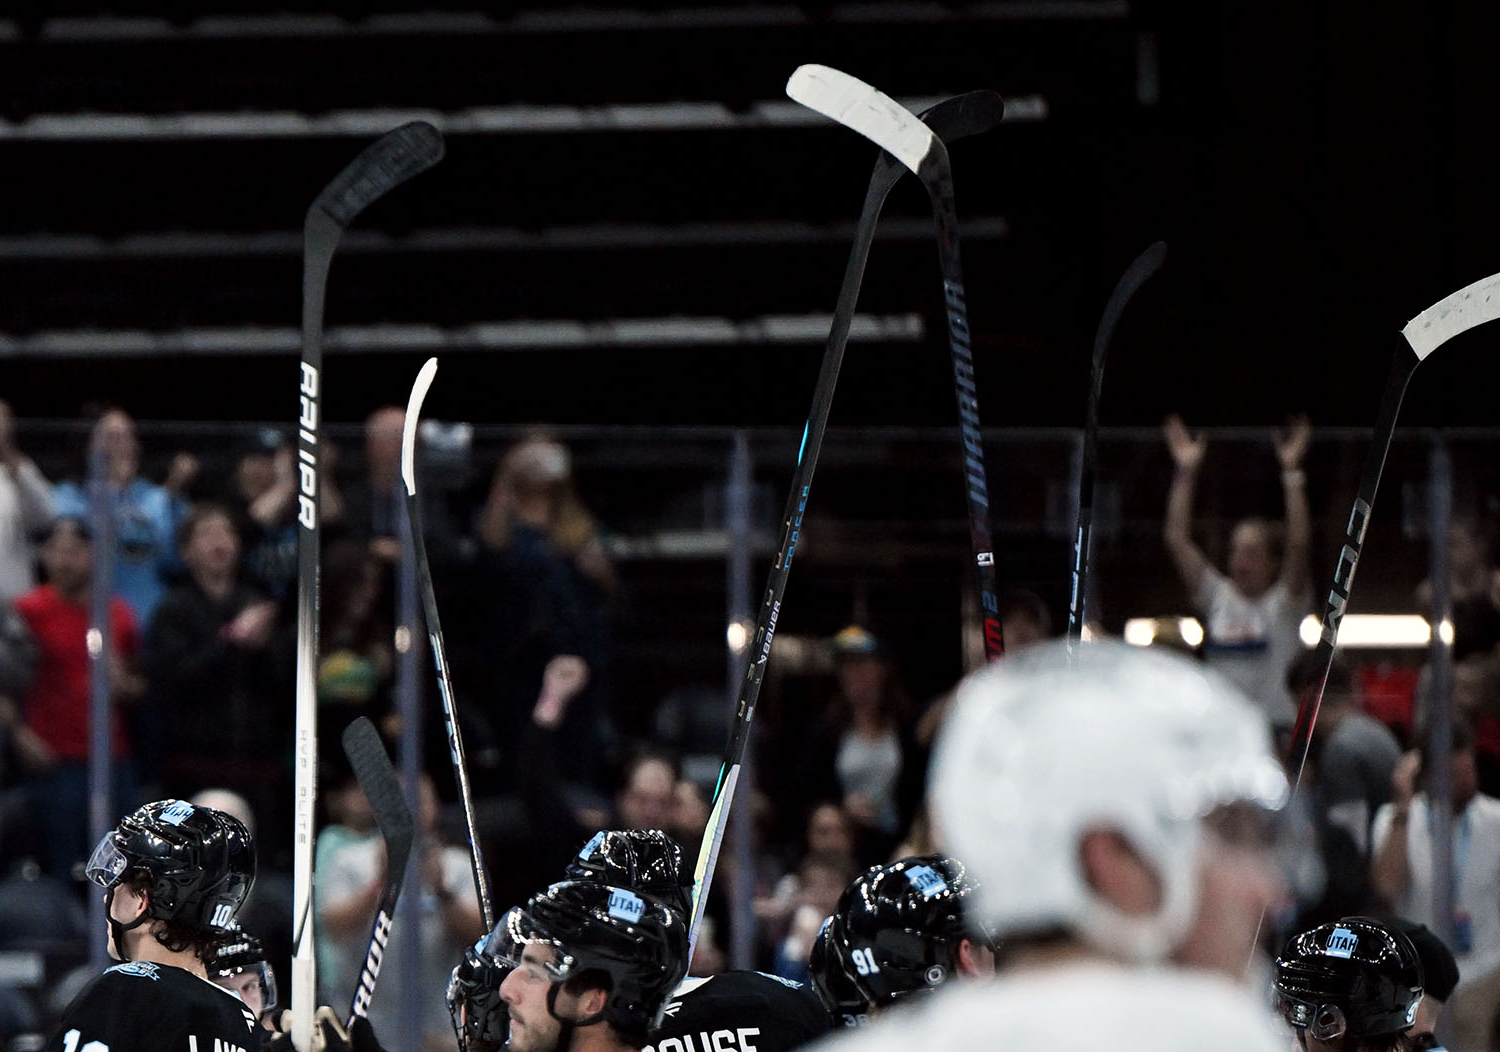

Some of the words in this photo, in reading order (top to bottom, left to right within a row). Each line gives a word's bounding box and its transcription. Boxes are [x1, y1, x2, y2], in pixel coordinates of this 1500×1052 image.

[1322, 498, 1370, 648] CCM
[763, 601, 781, 653] BAUER
[210, 904, 232, 928] 10
[609, 895, 644, 915] UTAH
[1327, 935, 1358, 952] UTAH
[852, 948, 880, 976] 91
